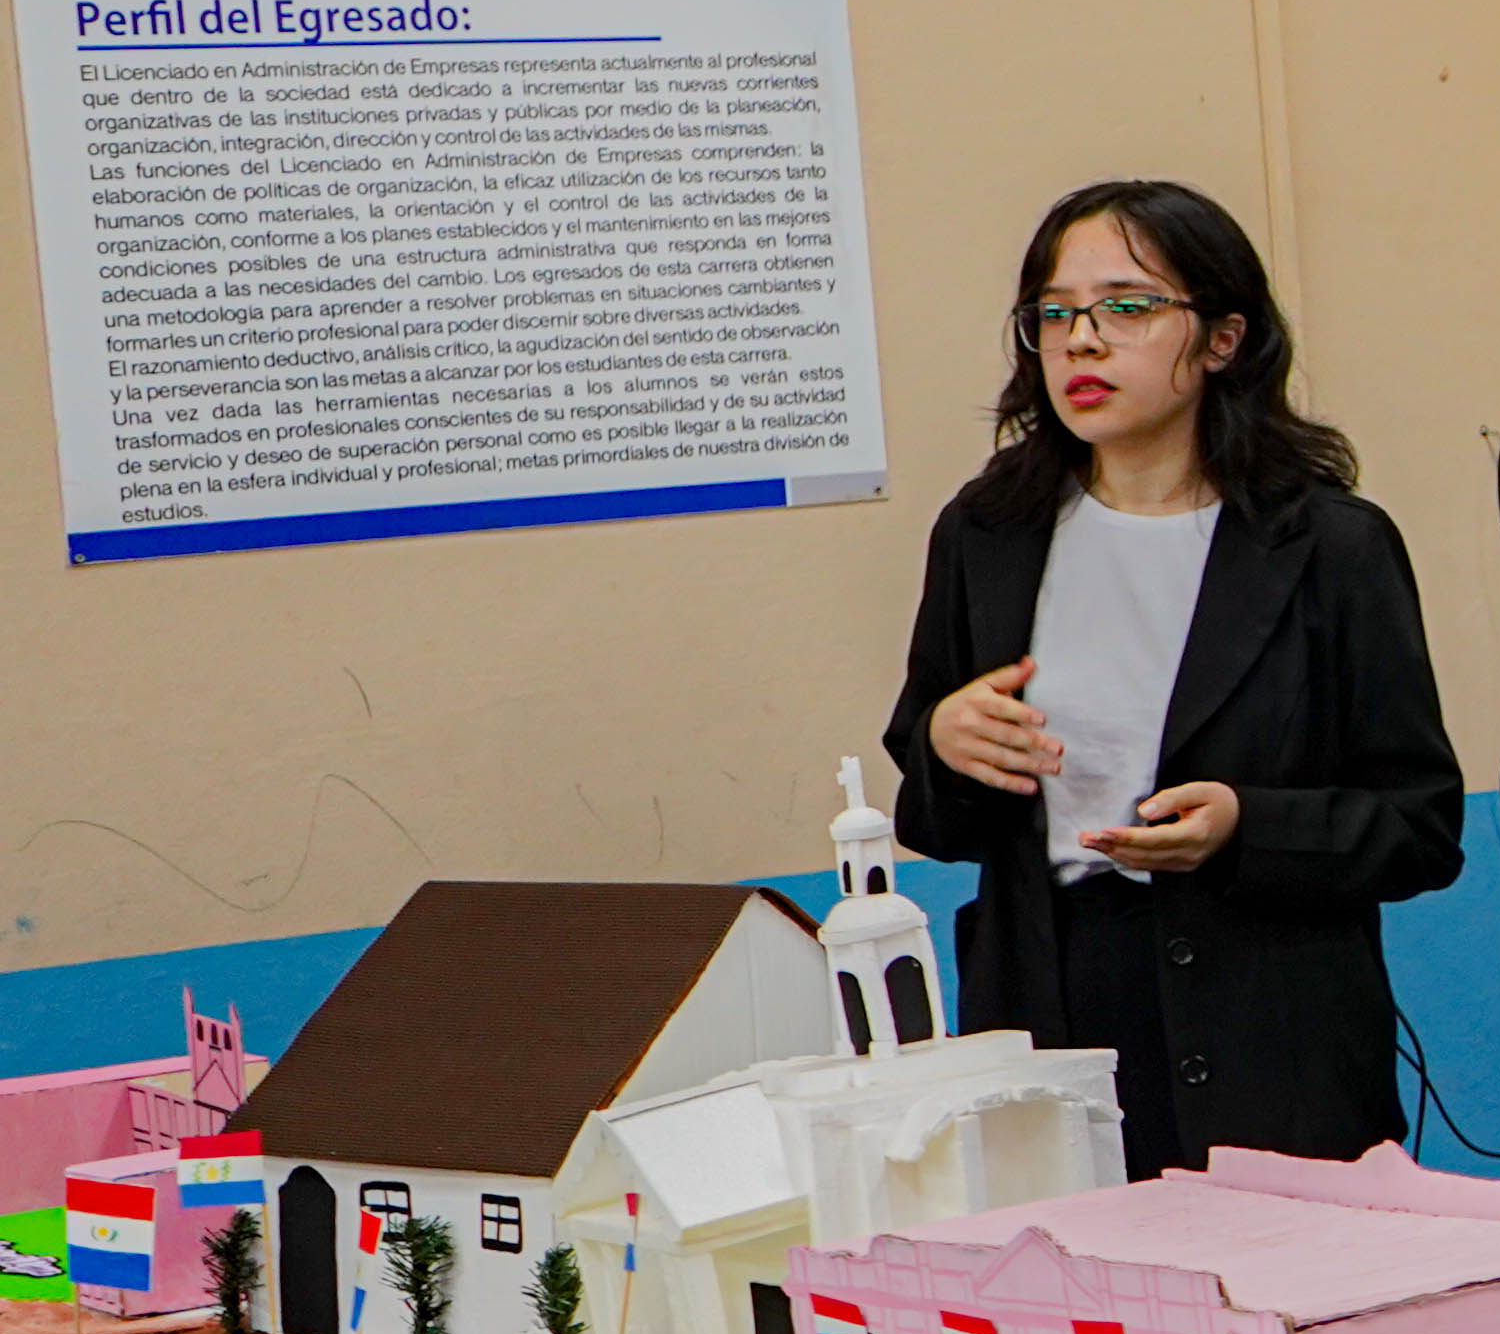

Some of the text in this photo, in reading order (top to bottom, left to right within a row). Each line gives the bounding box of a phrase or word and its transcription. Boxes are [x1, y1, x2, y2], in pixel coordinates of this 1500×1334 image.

[79, 50, 817, 82] El Licenciado en Administración de Empresas representa actualmente al profesional
[82, 74, 819, 111] que dentro de la sociedad está dedicado a incrementar las nuevas corrientes
[105, 301, 804, 353] formarles un criterio profesional para poder discernir sobre diversas actividades.
[109, 349, 790, 405] y la perseverancia son las metas a alcanzar por los estudiantes de esta carrera.
[121, 503, 208, 523] estudios.
